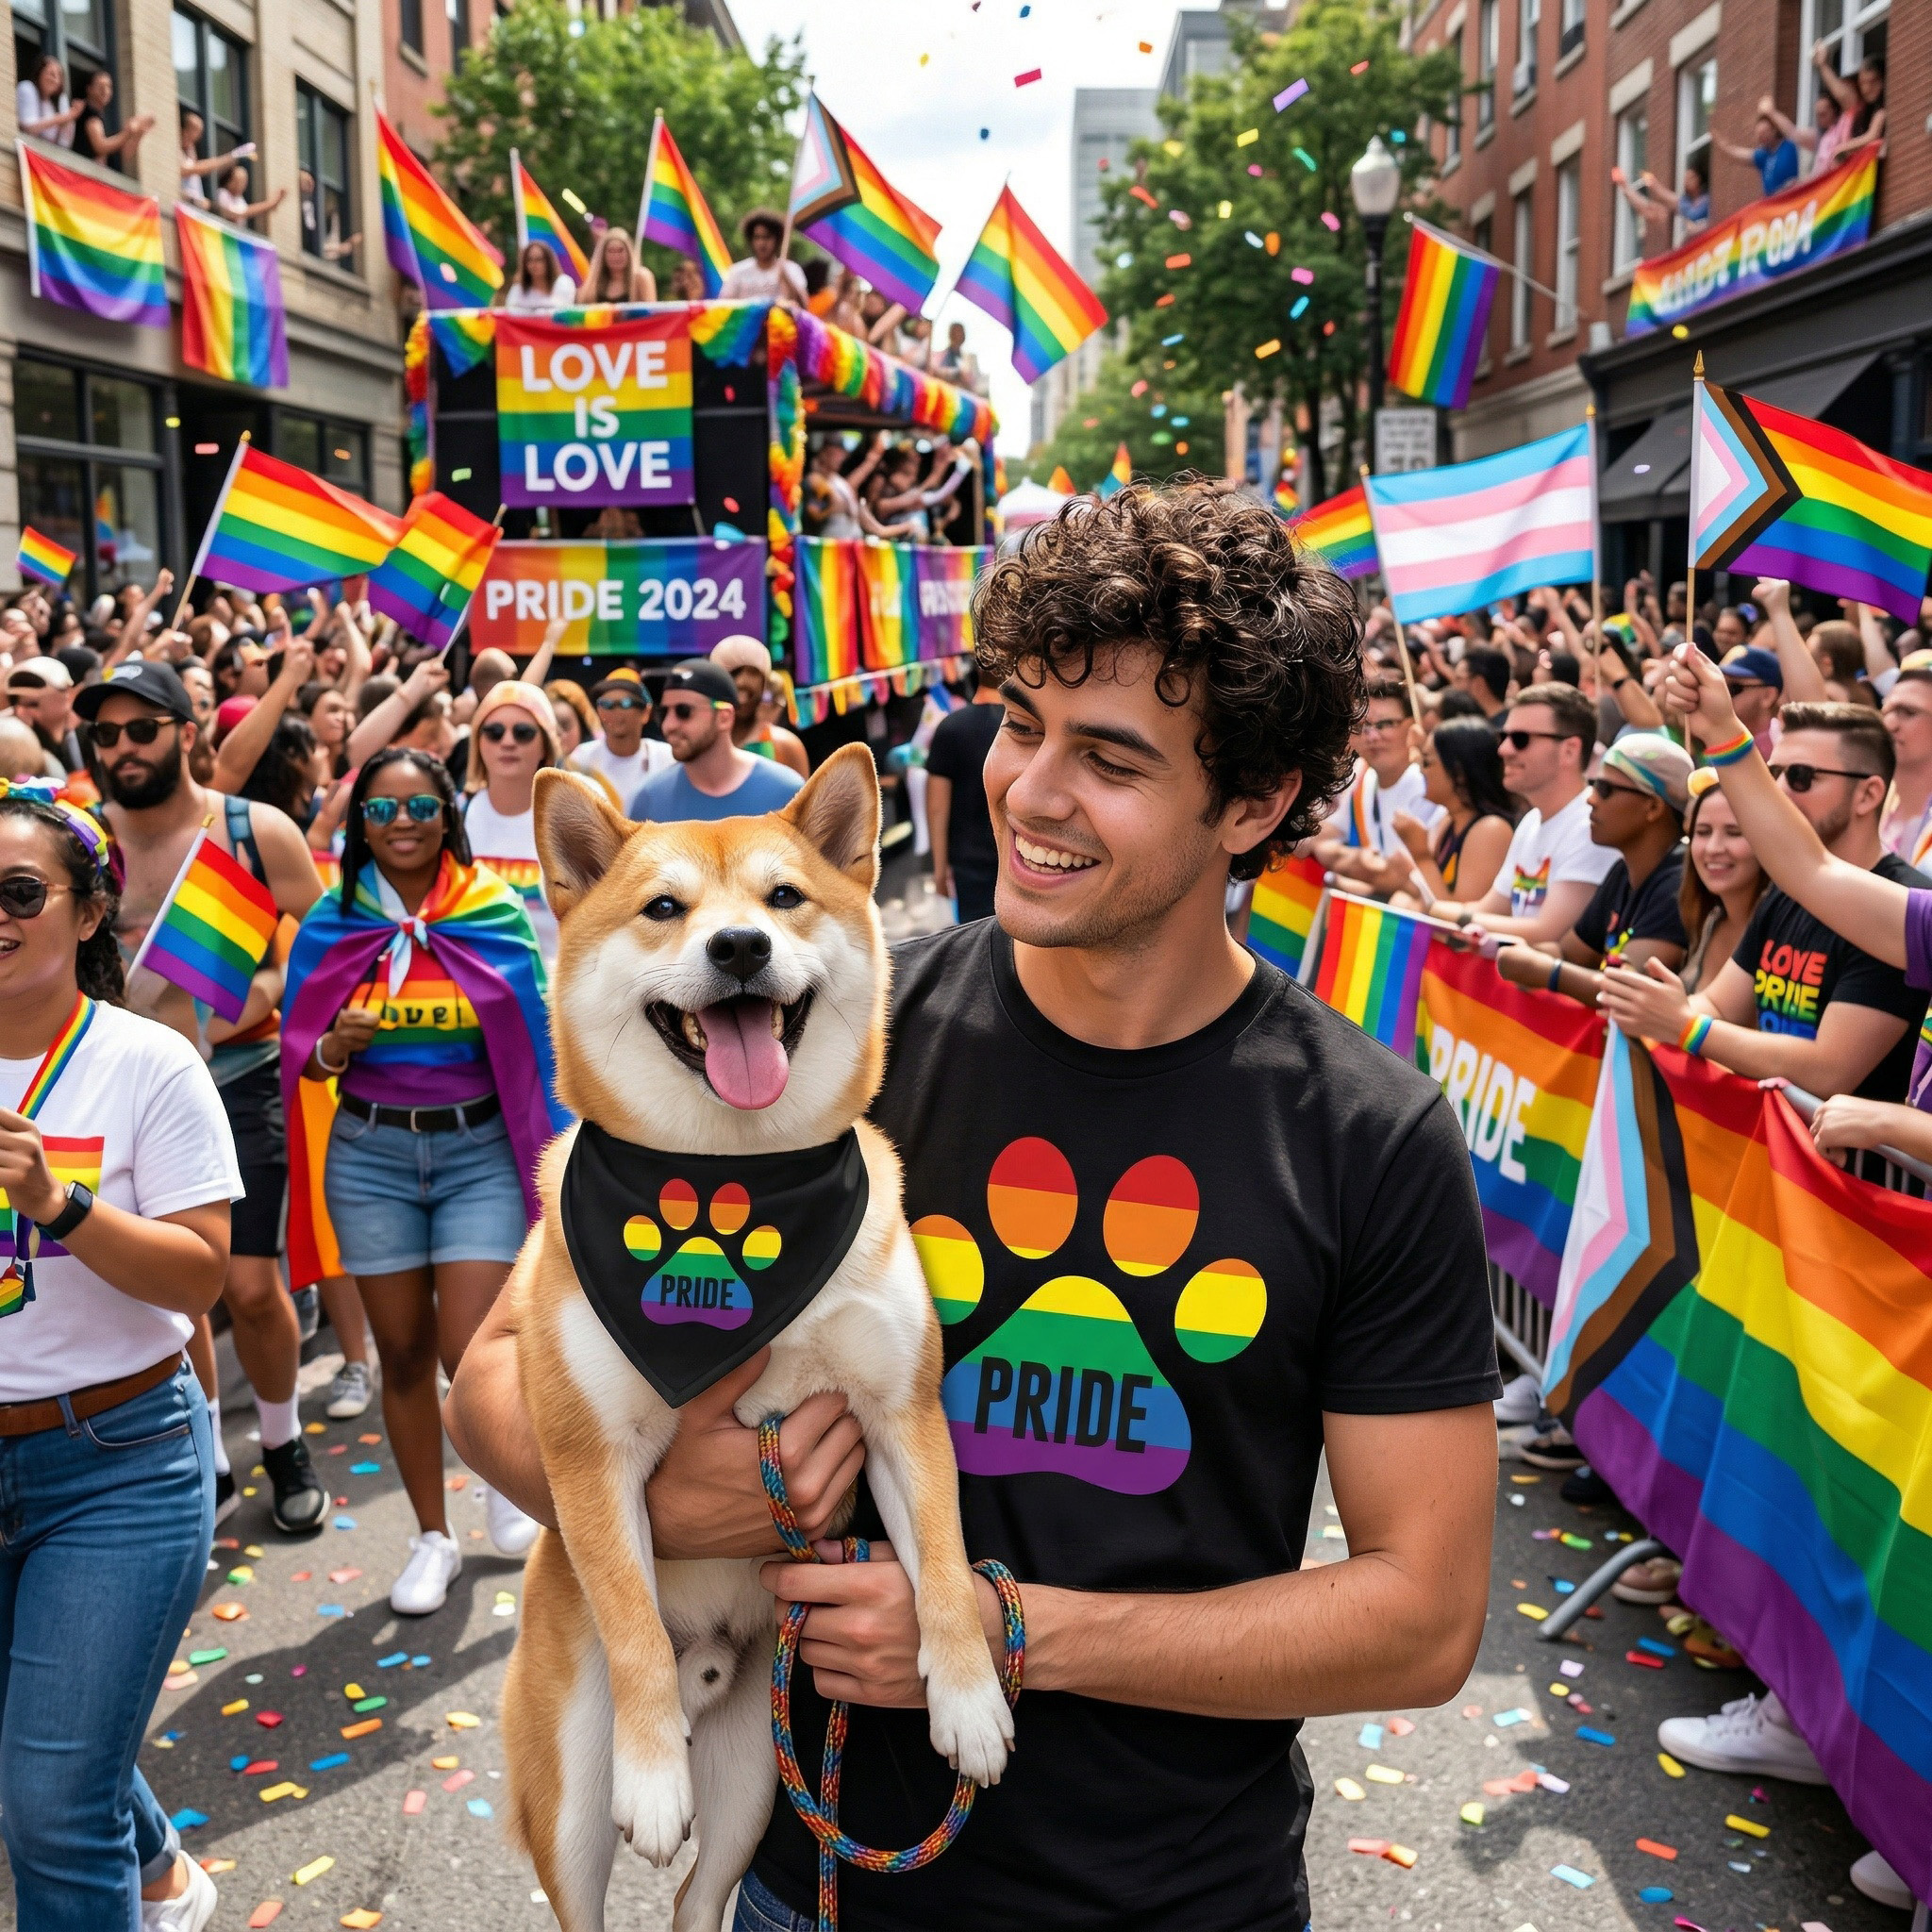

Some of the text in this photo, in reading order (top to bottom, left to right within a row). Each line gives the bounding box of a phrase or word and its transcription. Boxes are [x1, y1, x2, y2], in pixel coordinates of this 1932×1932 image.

[520, 340, 668, 393] LOVE
[575, 395, 620, 439] IS
[525, 441, 672, 492] LOVE
[486, 577, 747, 621] PRIDE 2024
[1759, 939, 1828, 986] LOVE
[1429, 1024, 1537, 1186] PRIDE
[660, 1274, 735, 1310] PRIDE
[974, 1356, 1153, 1453] PRIDE
